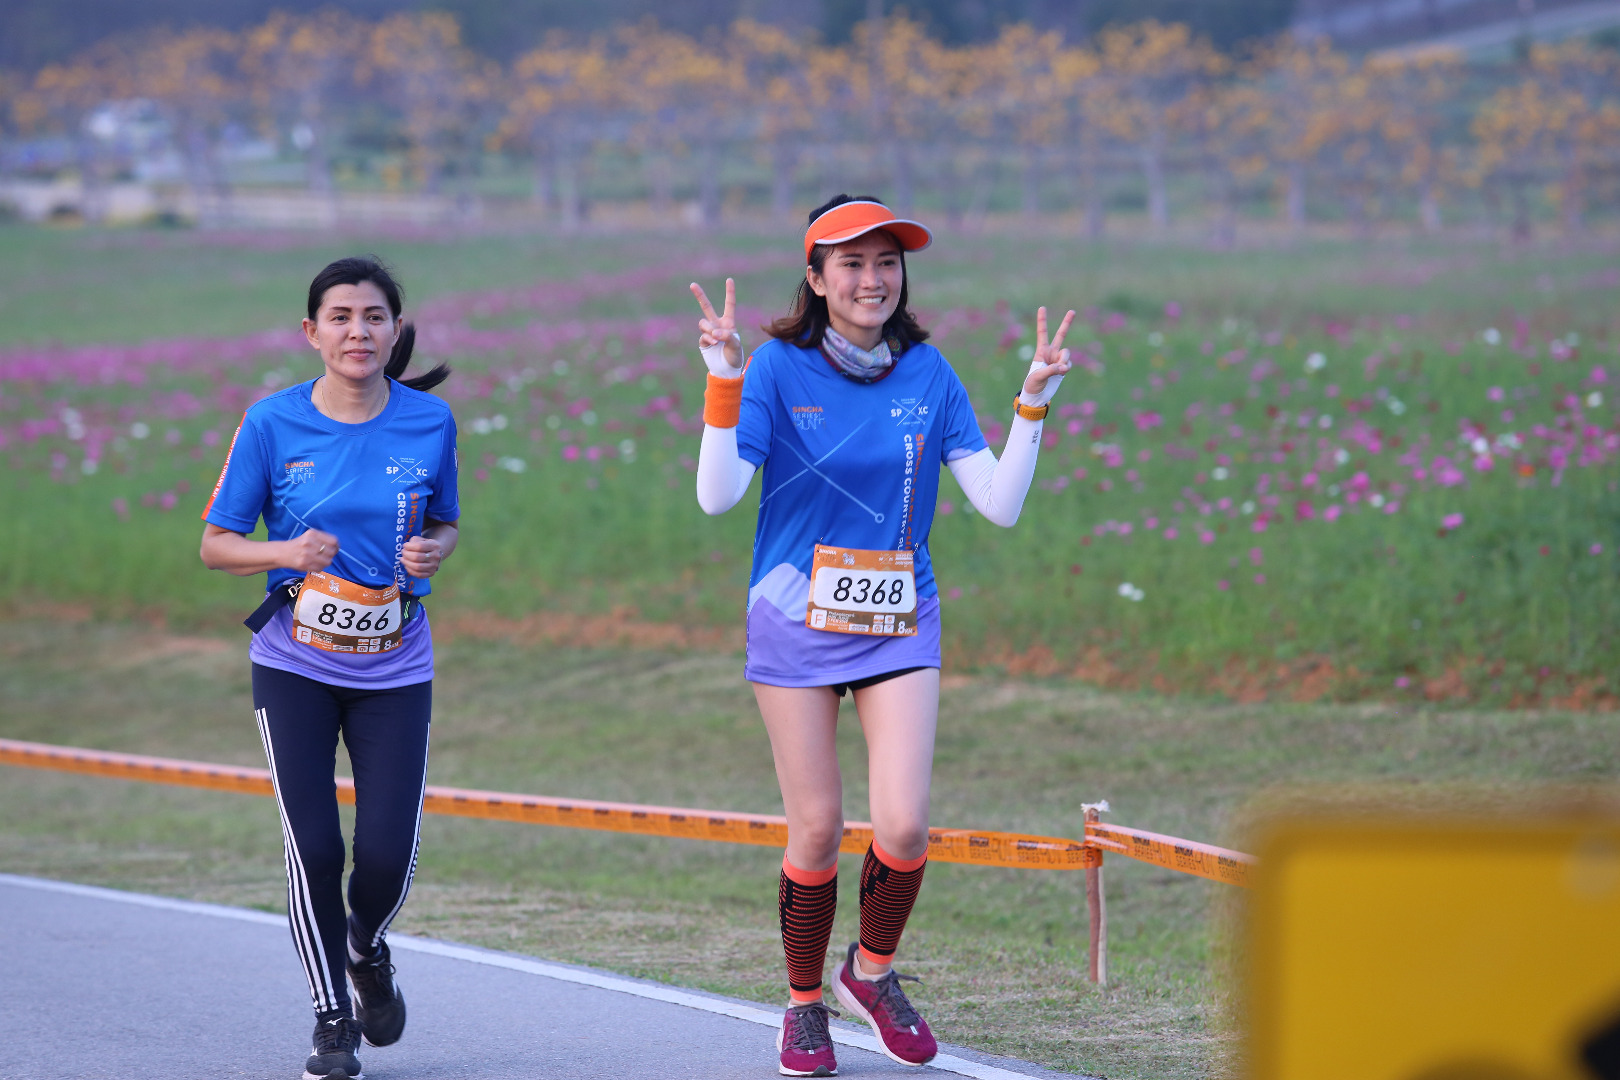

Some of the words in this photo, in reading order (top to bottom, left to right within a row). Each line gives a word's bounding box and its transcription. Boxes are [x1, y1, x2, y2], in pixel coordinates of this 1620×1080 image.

[890, 408, 902, 417] SP
[918, 406, 928, 415] XC
[903, 434, 913, 475] CROSS
[284, 461, 315, 469] SINGHA
[385, 466, 399, 474] SP
[416, 468, 428, 476] XC
[396, 492, 406, 532] CROSS
[901, 477, 912, 534] COUNTRY
[833, 576, 904, 605] 8368
[318, 602, 390, 632] 8366
[815, 614, 824, 625] F
[300, 630, 309, 640] F
